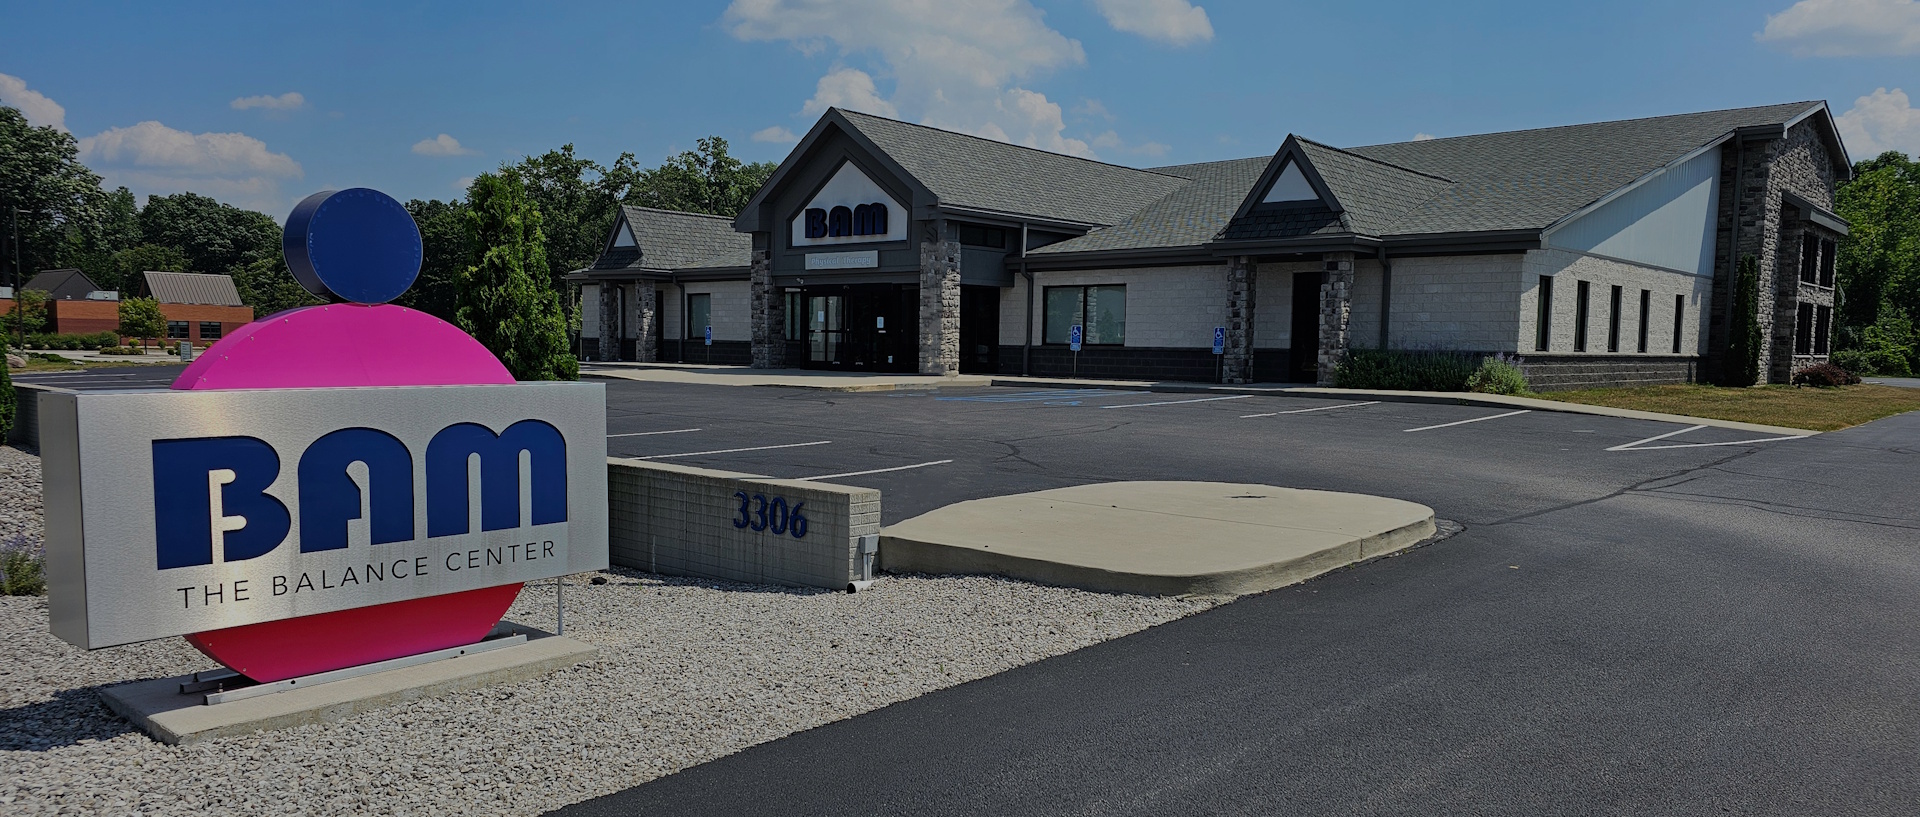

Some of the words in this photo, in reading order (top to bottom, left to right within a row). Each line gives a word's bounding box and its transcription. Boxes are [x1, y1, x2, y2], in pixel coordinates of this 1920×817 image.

[805, 202, 888, 239] BAM
[811, 256, 839, 266] Physical
[152, 418, 568, 570] BAM
[733, 491, 807, 538] 3306
[177, 580, 250, 609] THE
[272, 556, 428, 596] BALANCE
[446, 540, 555, 571] CENTER
